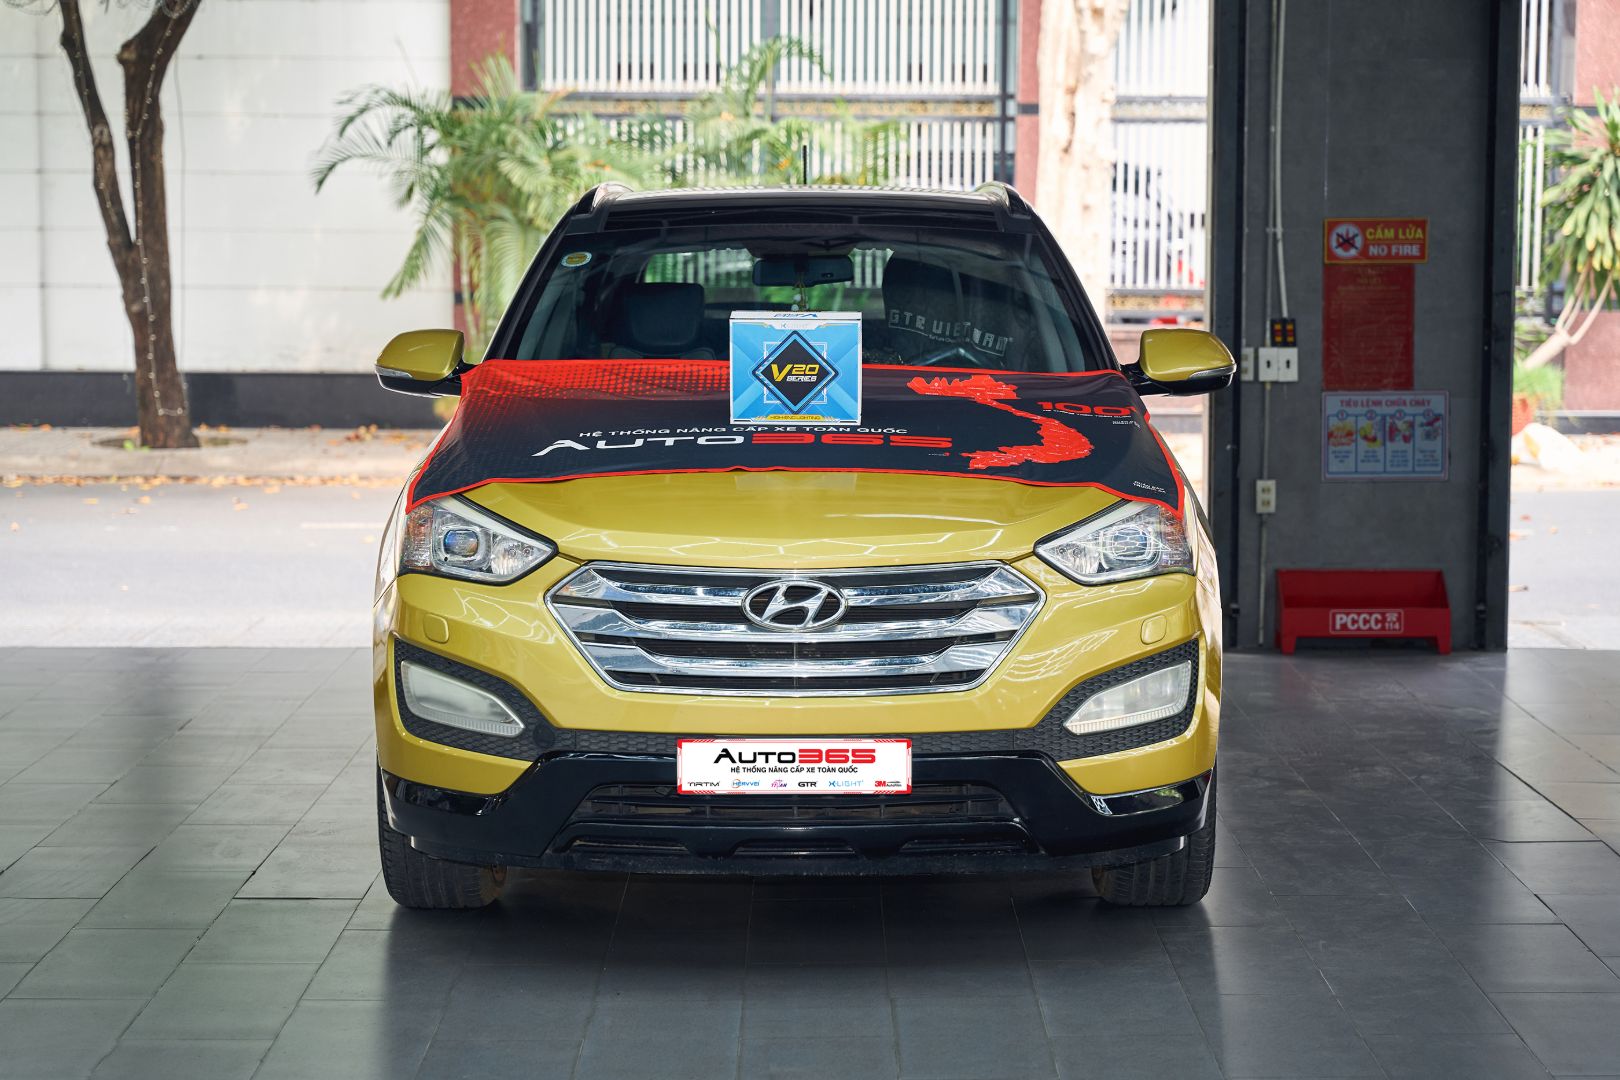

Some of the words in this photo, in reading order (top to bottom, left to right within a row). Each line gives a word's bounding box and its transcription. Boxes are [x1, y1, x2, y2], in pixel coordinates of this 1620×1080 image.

[1366, 224, 1394, 239] CẤM
[1398, 224, 1424, 239] LỬA
[1369, 244, 1388, 256] NO
[1391, 244, 1420, 256] FIRE
[608, 427, 670, 436] THỐNG
[857, 426, 908, 434] QUỐC
[1335, 613, 1382, 630] PCCC
[1385, 622, 1399, 630] 114
[730, 766, 740, 774] HỆ
[742, 765, 767, 773] THỐNG
[790, 764, 804, 773] CẤP
[817, 765, 836, 773] TOÀN
[838, 764, 858, 774] QUỐC
